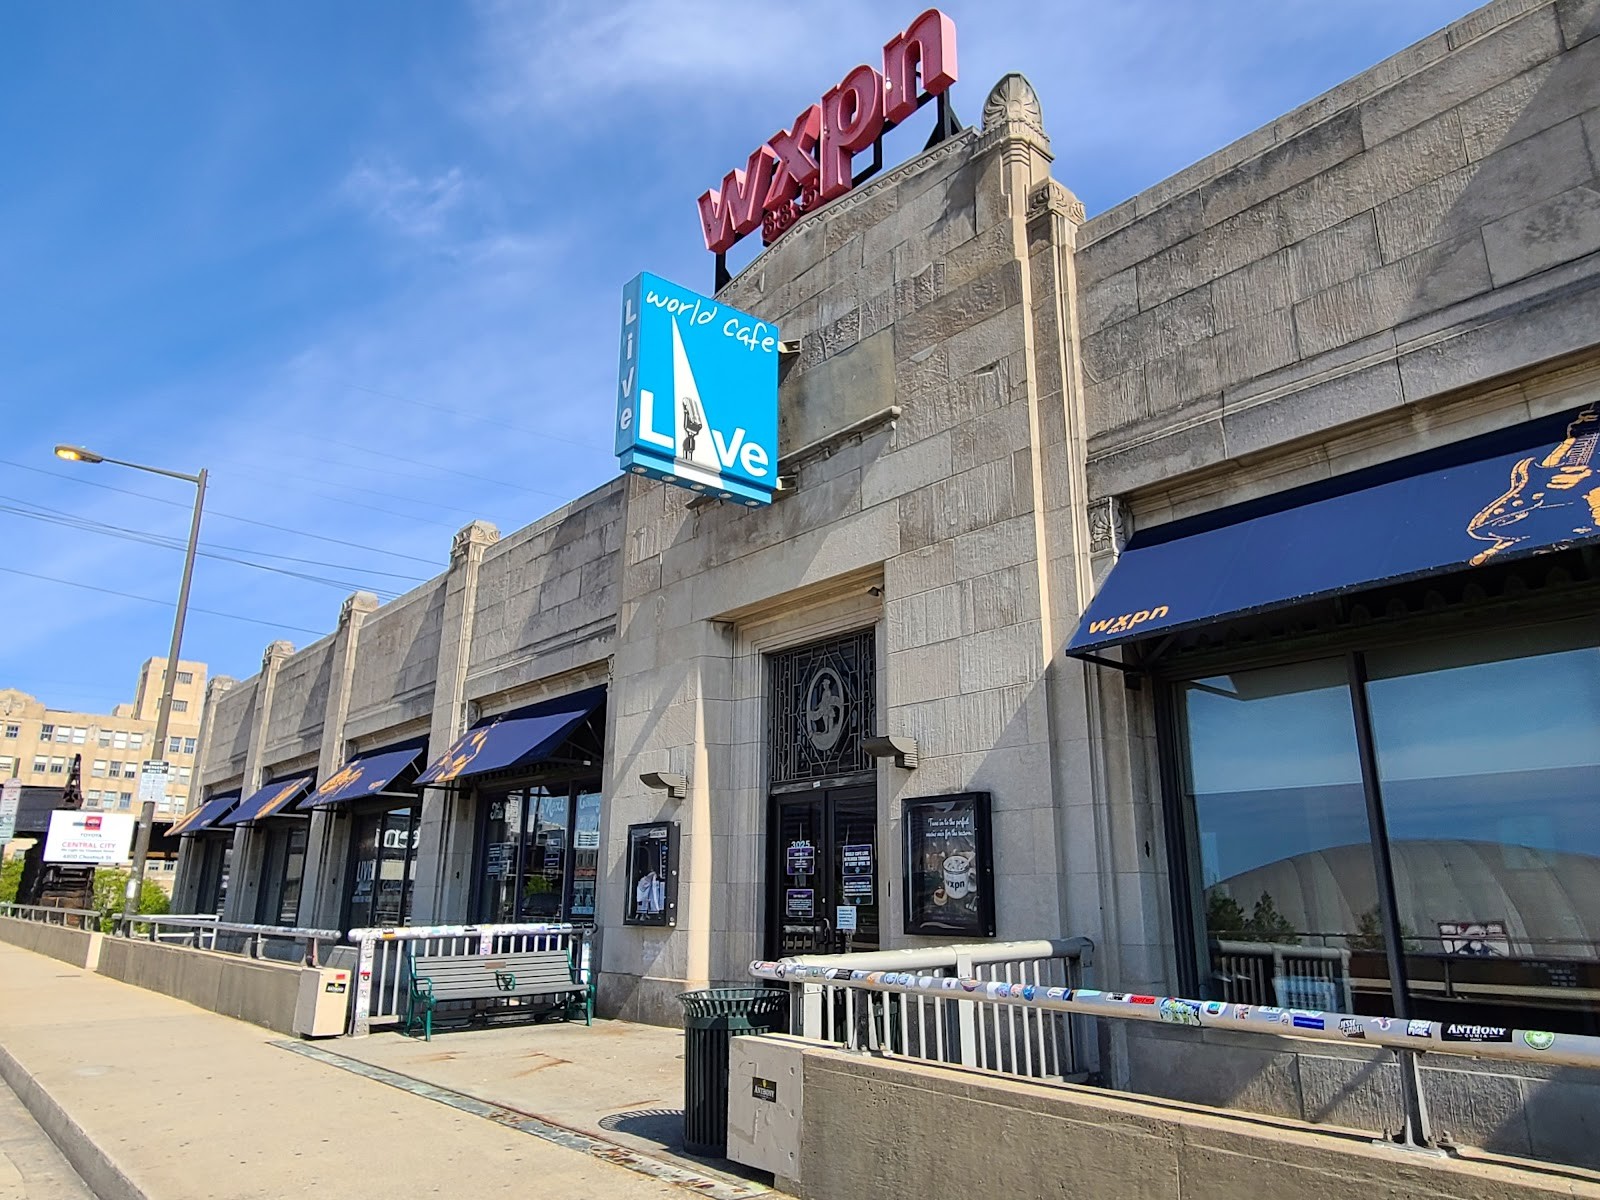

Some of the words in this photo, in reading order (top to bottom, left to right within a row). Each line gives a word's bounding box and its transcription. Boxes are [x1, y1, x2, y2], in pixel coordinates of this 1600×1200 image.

[697, 8, 958, 254] wxpn
[646, 288, 718, 326] world
[723, 317, 775, 354] cafe
[619, 299, 638, 430] Live
[1089, 605, 1169, 635] wxpn
[61, 841, 98, 849] CENTRAL
[791, 839, 811, 848] 3025
[1447, 1023, 1506, 1036] ANTHONY
